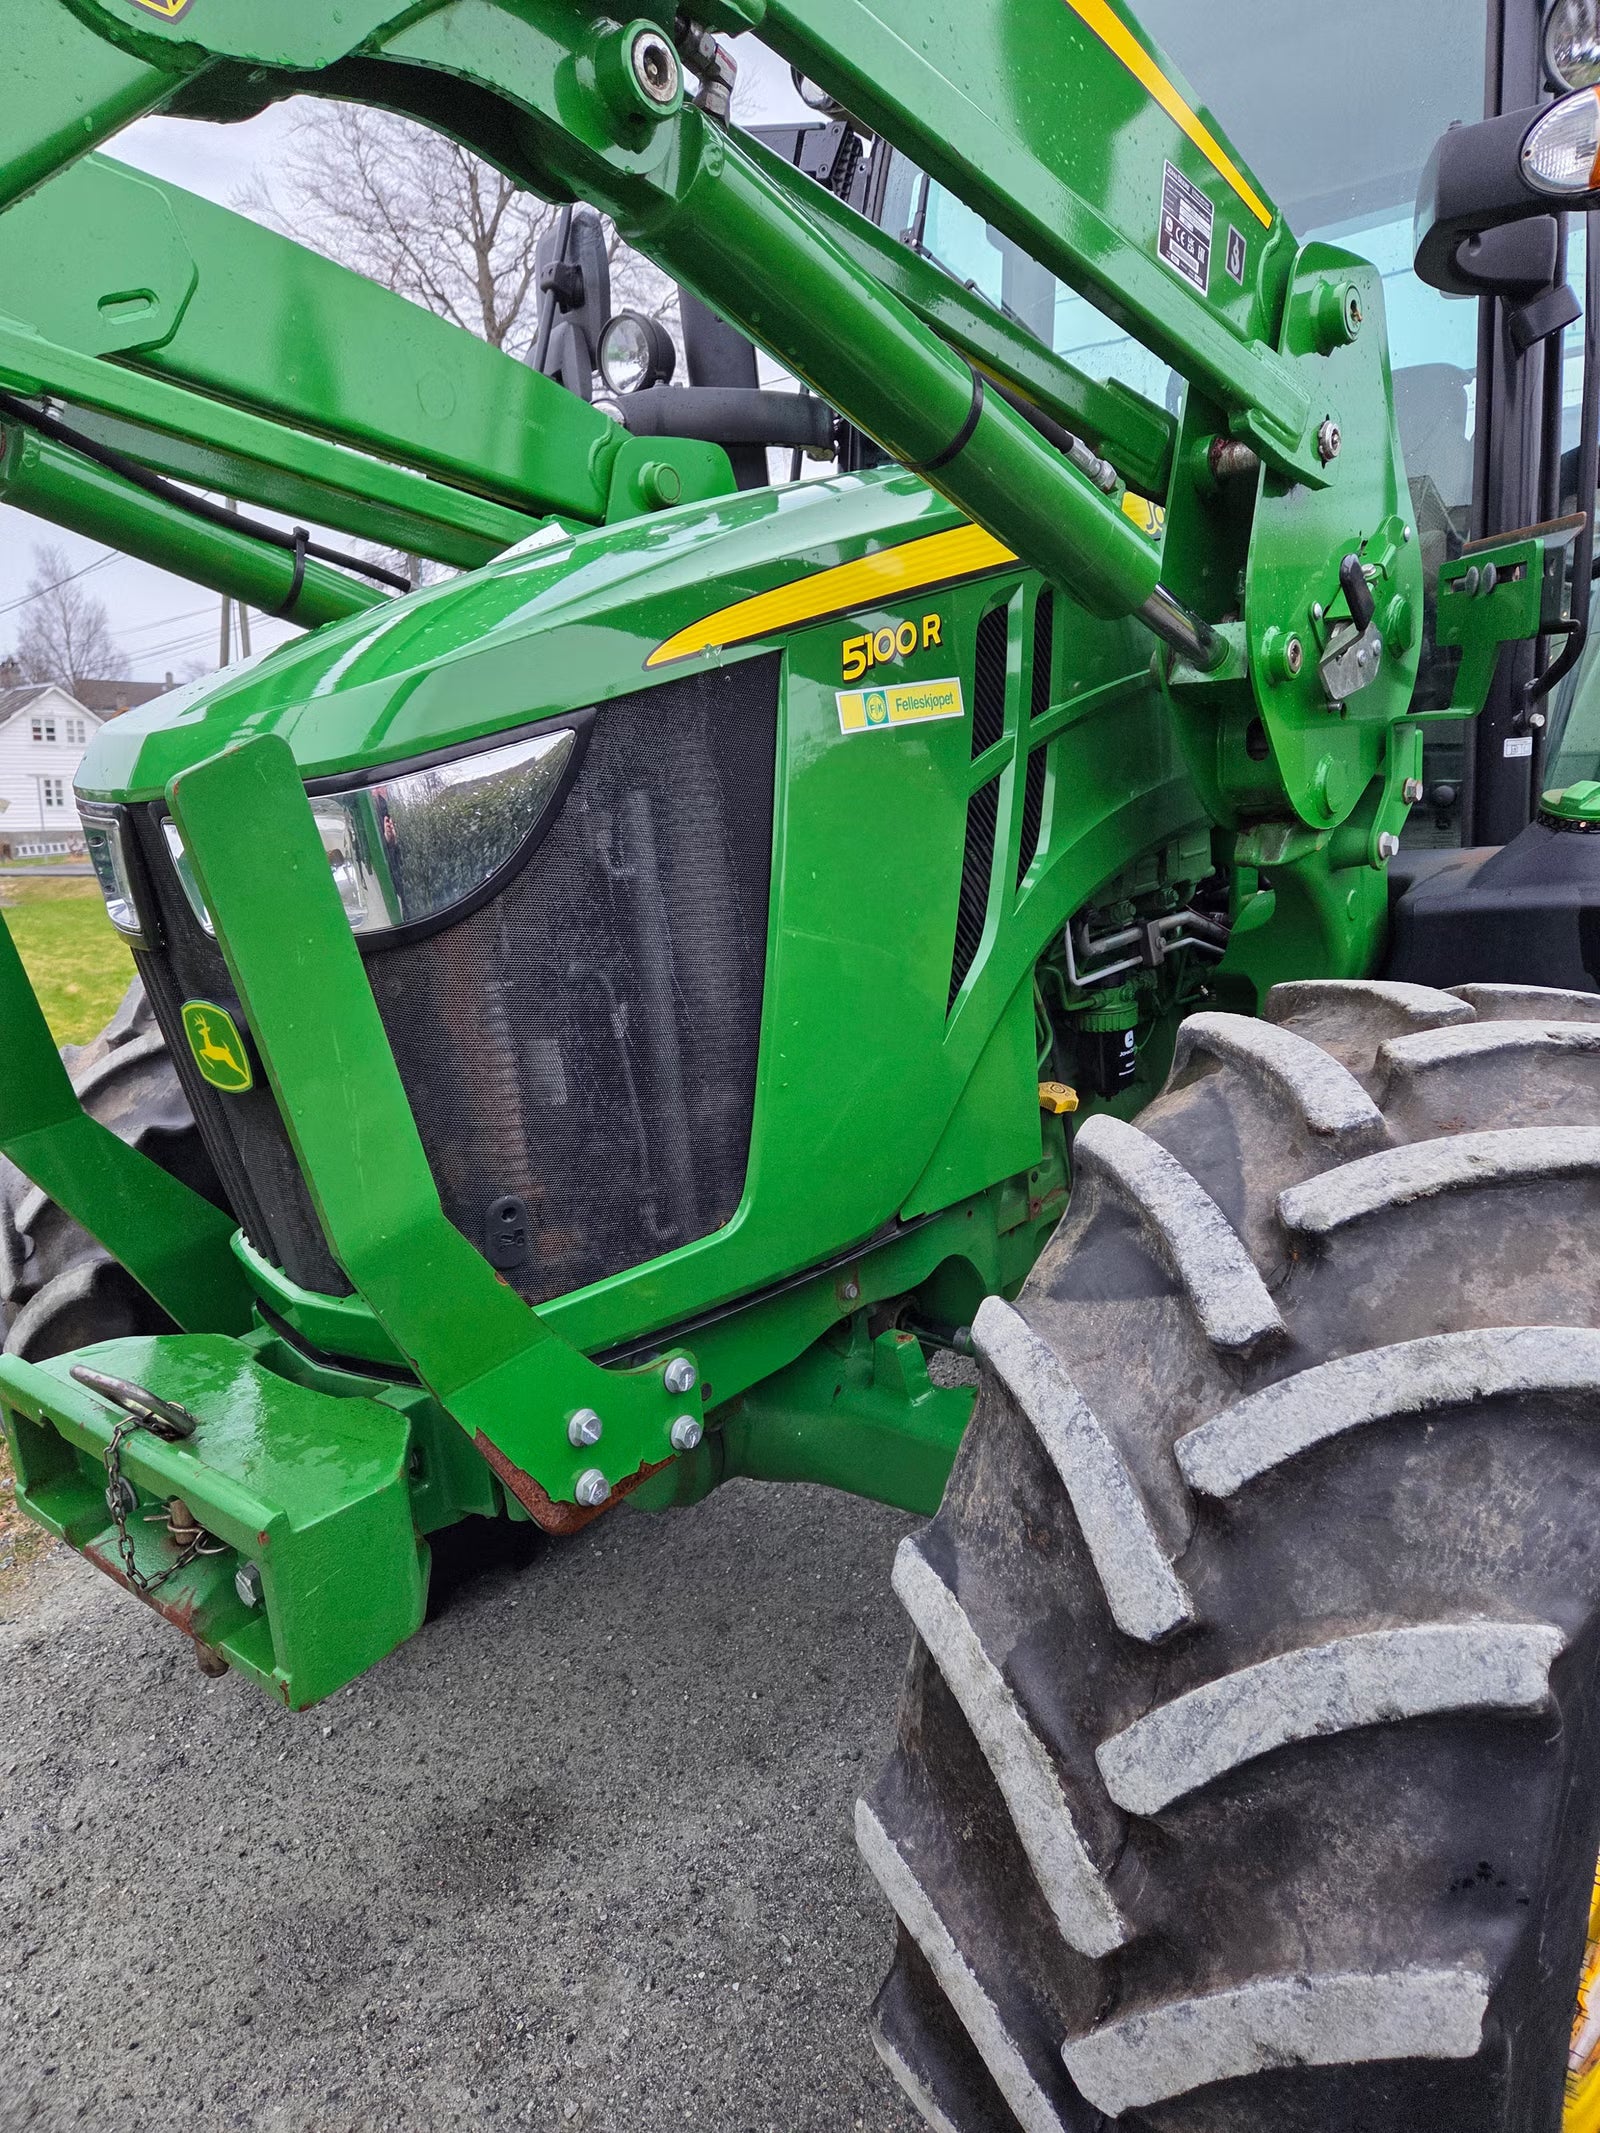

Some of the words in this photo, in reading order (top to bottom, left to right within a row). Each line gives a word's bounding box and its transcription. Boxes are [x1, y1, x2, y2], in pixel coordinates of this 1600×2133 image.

[842, 620, 919, 683] 5100
[922, 612, 943, 651] R
[895, 691, 954, 713] Felleskjøpet
